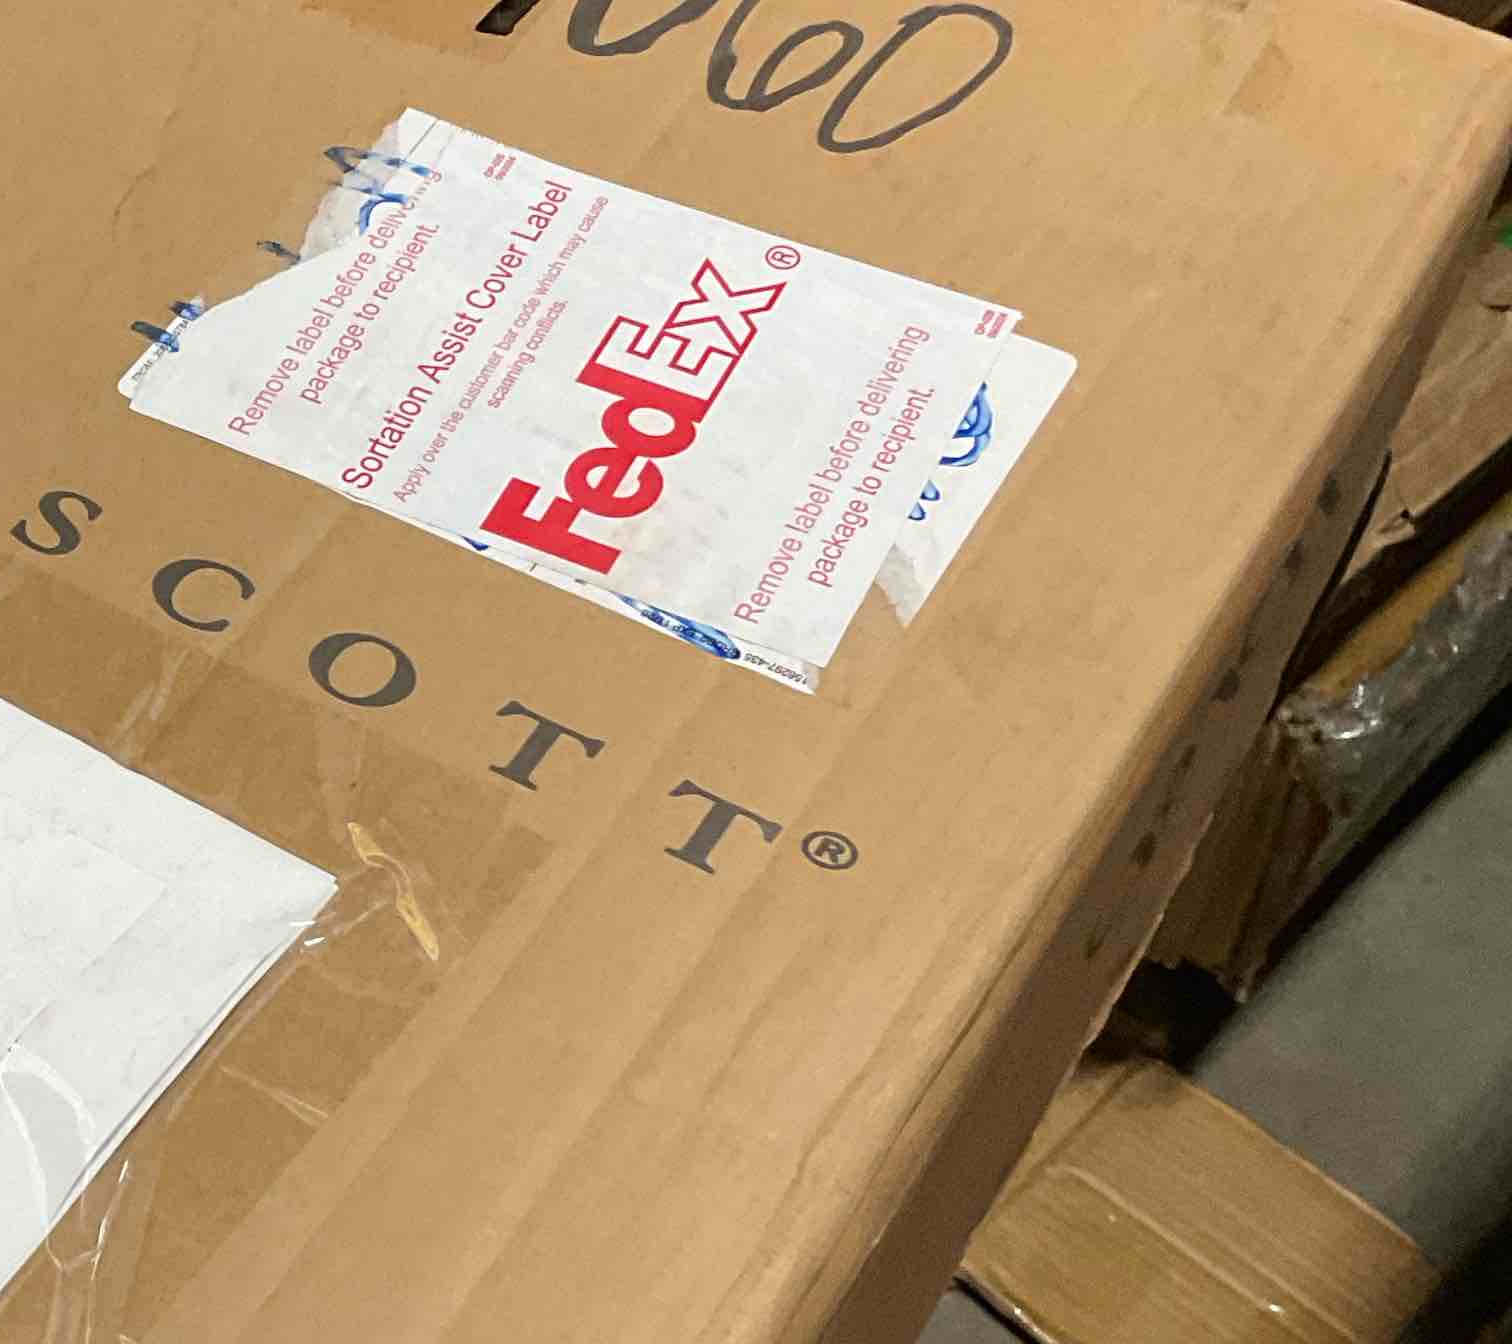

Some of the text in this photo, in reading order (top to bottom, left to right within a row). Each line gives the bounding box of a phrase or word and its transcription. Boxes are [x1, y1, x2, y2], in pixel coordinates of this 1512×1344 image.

[227, 166, 443, 436] Remove label before delivg
[299, 224, 440, 404] package to recipient.
[341, 385, 433, 489] Sortation
[417, 311, 483, 384] Assist
[465, 242, 528, 309] Cover
[510, 179, 572, 242] Label
[392, 195, 609, 503] Apply over the customer bar code which may cause
[487, 350, 536, 408] scanning
[733, 325, 931, 624] Remove label before delivering
[807, 387, 935, 588] package to recipient.
